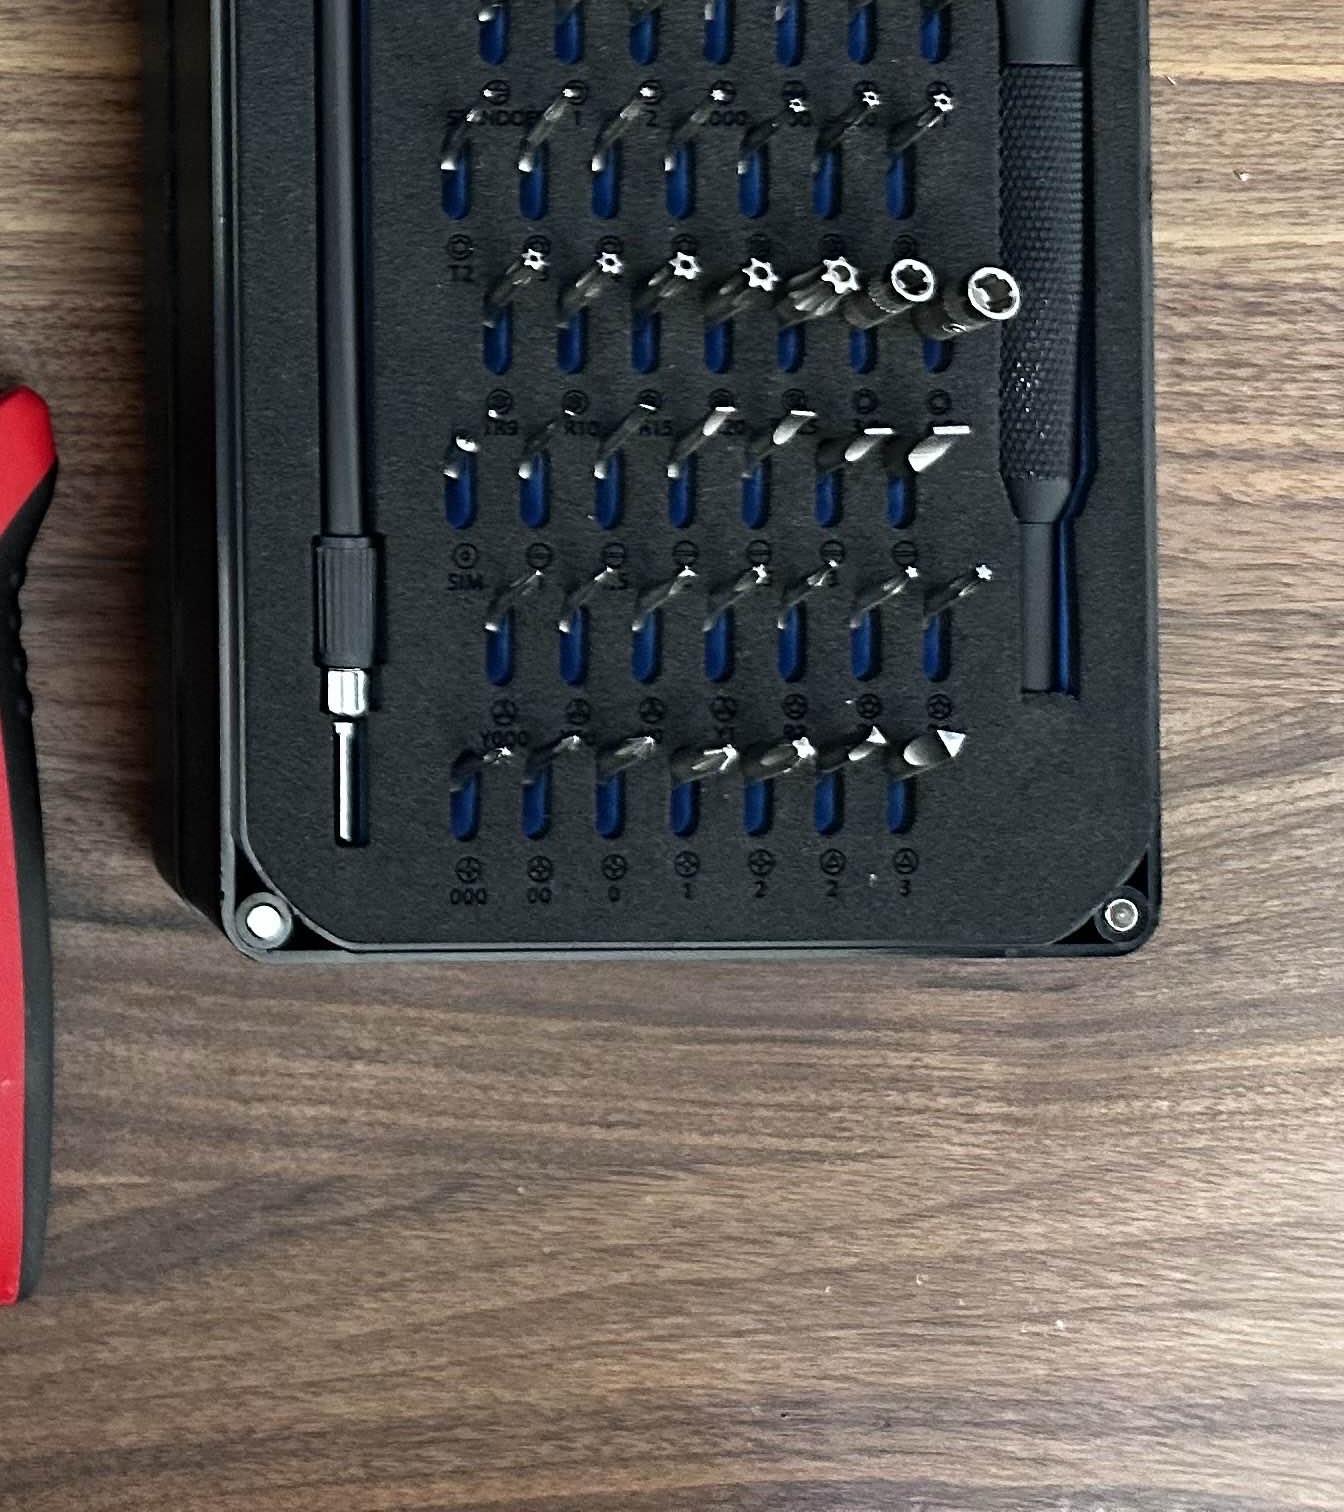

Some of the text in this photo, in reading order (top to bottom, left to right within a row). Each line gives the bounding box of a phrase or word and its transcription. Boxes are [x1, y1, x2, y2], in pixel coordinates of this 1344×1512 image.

[450, 887, 488, 905] 000
[527, 886, 552, 904] 00
[899, 878, 913, 898] 3
